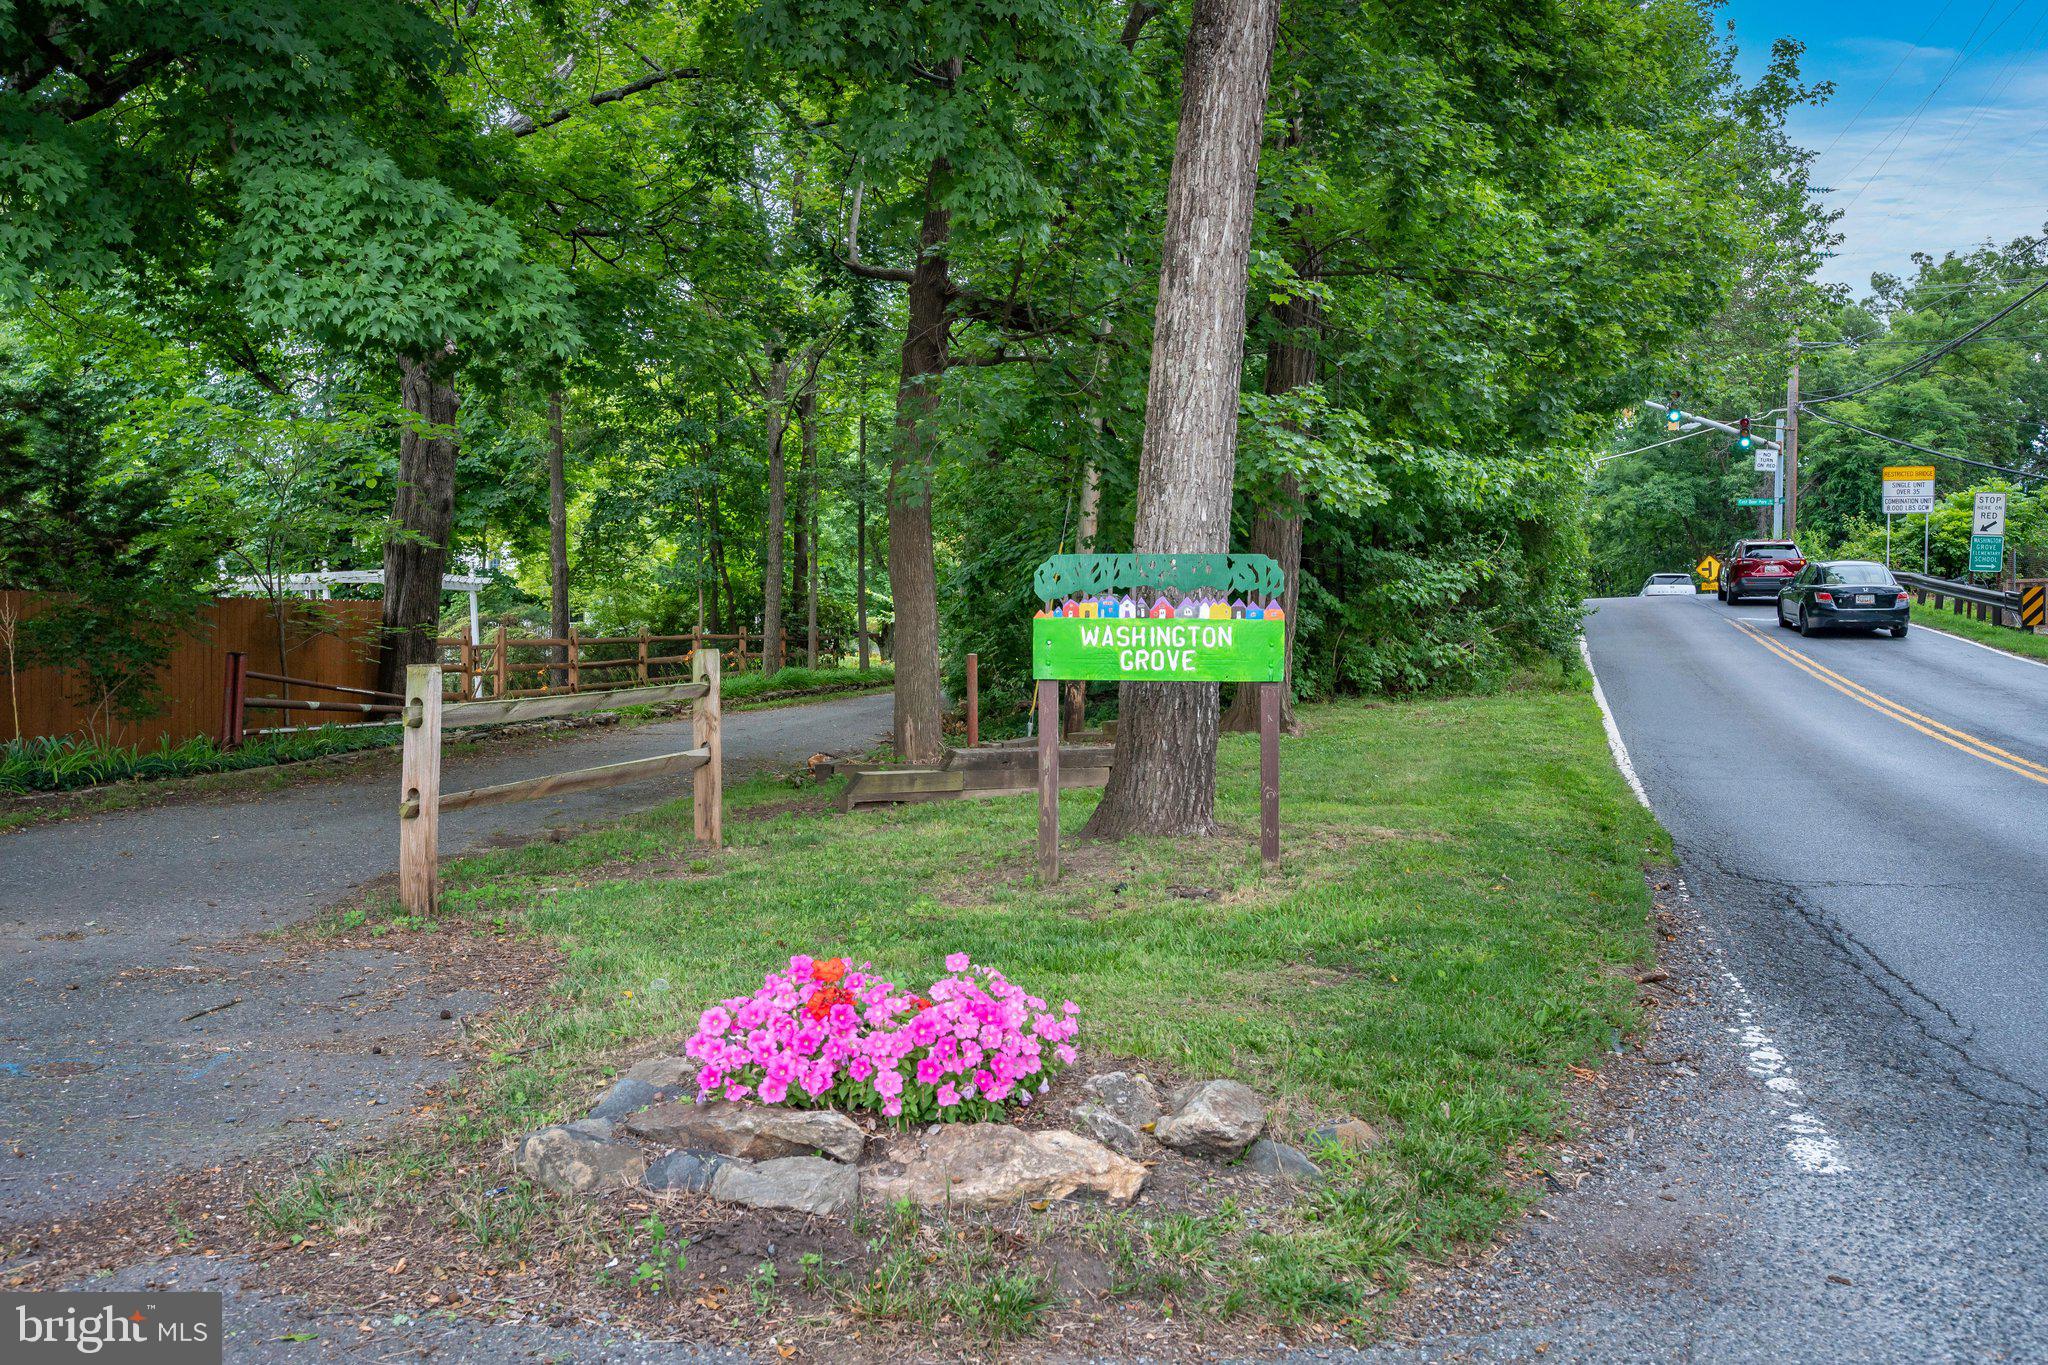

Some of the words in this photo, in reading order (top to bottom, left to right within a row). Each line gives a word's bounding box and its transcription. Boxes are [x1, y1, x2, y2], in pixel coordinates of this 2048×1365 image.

[1979, 496, 2002, 504] STOP
[1080, 624, 1233, 648] WASHINGTON
[1120, 649, 1196, 671] GROVE
